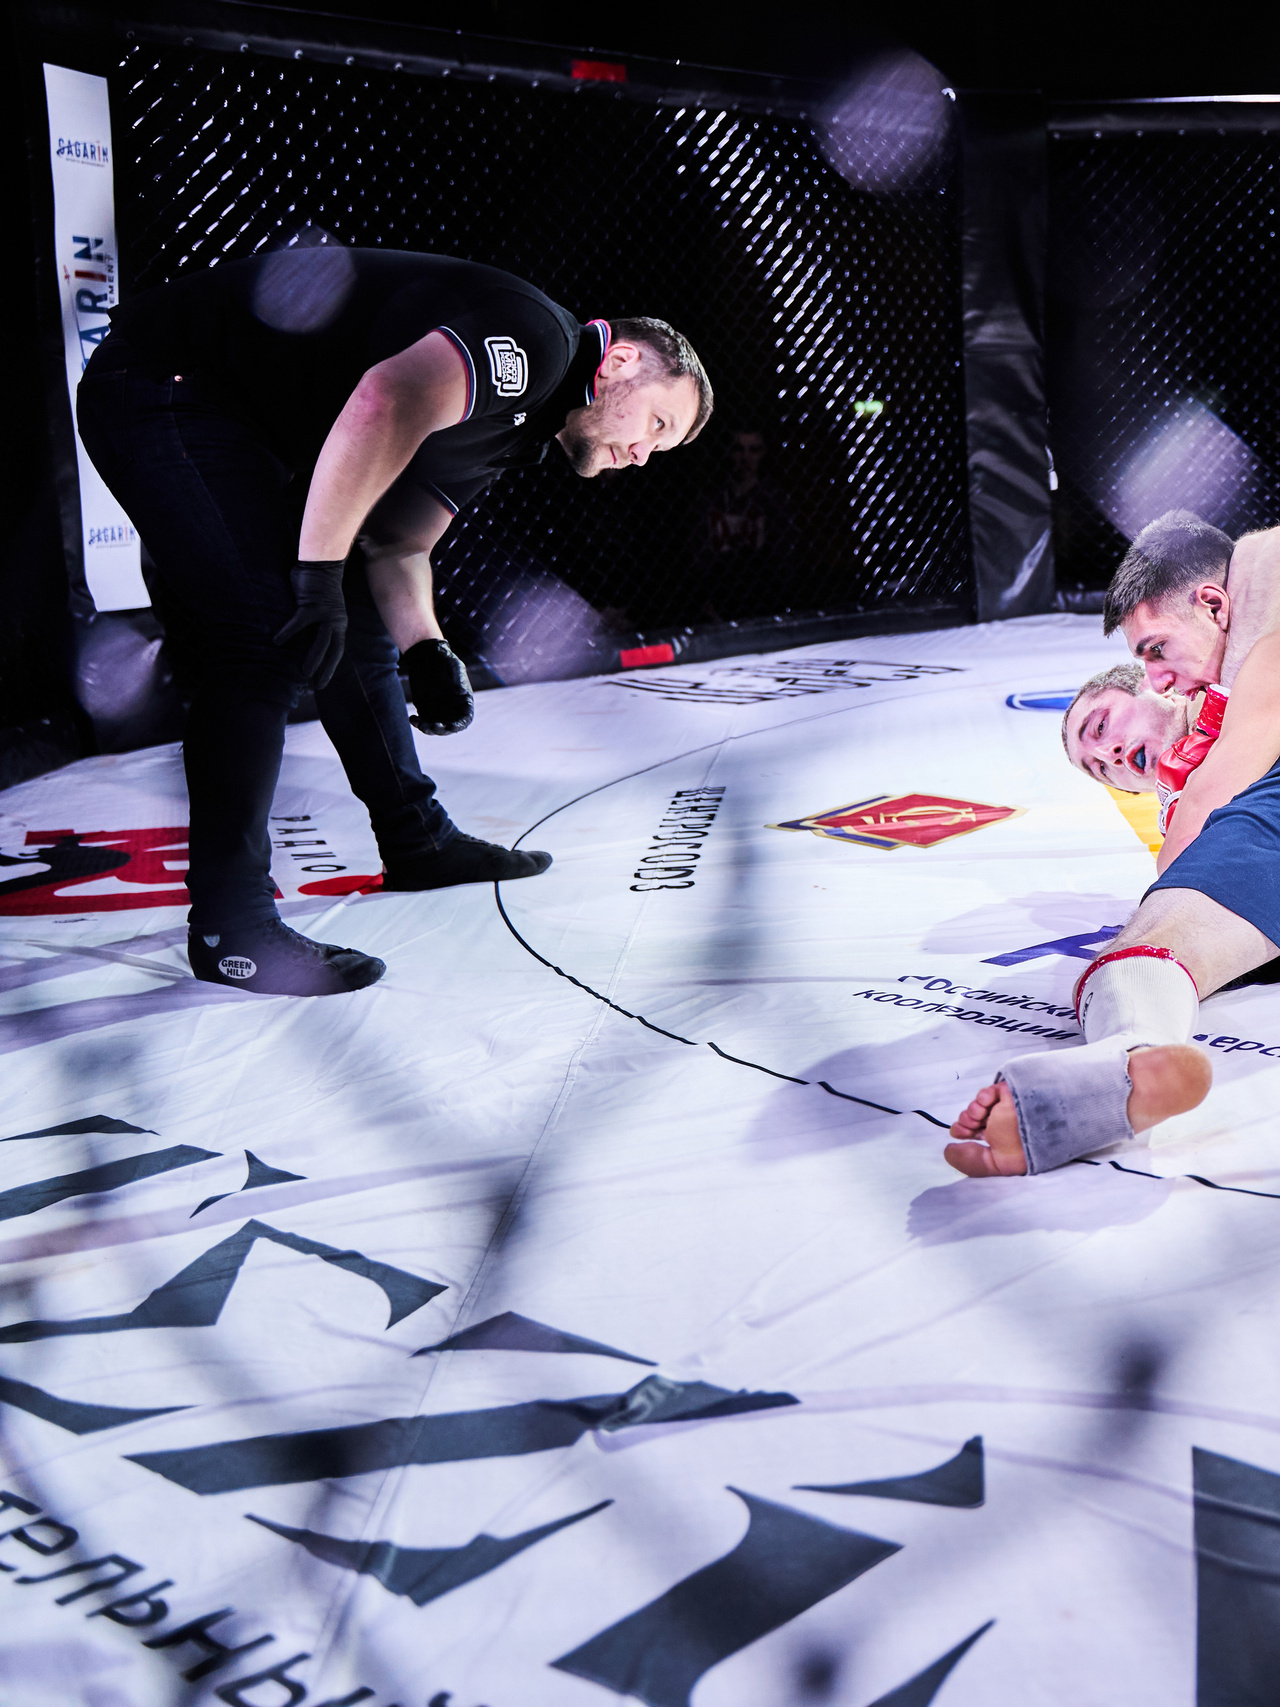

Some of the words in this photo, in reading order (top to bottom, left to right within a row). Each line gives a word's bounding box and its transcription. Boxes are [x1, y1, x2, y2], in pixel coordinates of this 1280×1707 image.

[72, 236, 110, 372] ARIN
[270, 815, 347, 873] РАДИО
[221, 959, 252, 970] GREEN
[226, 968, 246, 977] HILL
[853, 989, 1079, 1040] кооперации
[898, 975, 1077, 1020] Российски
